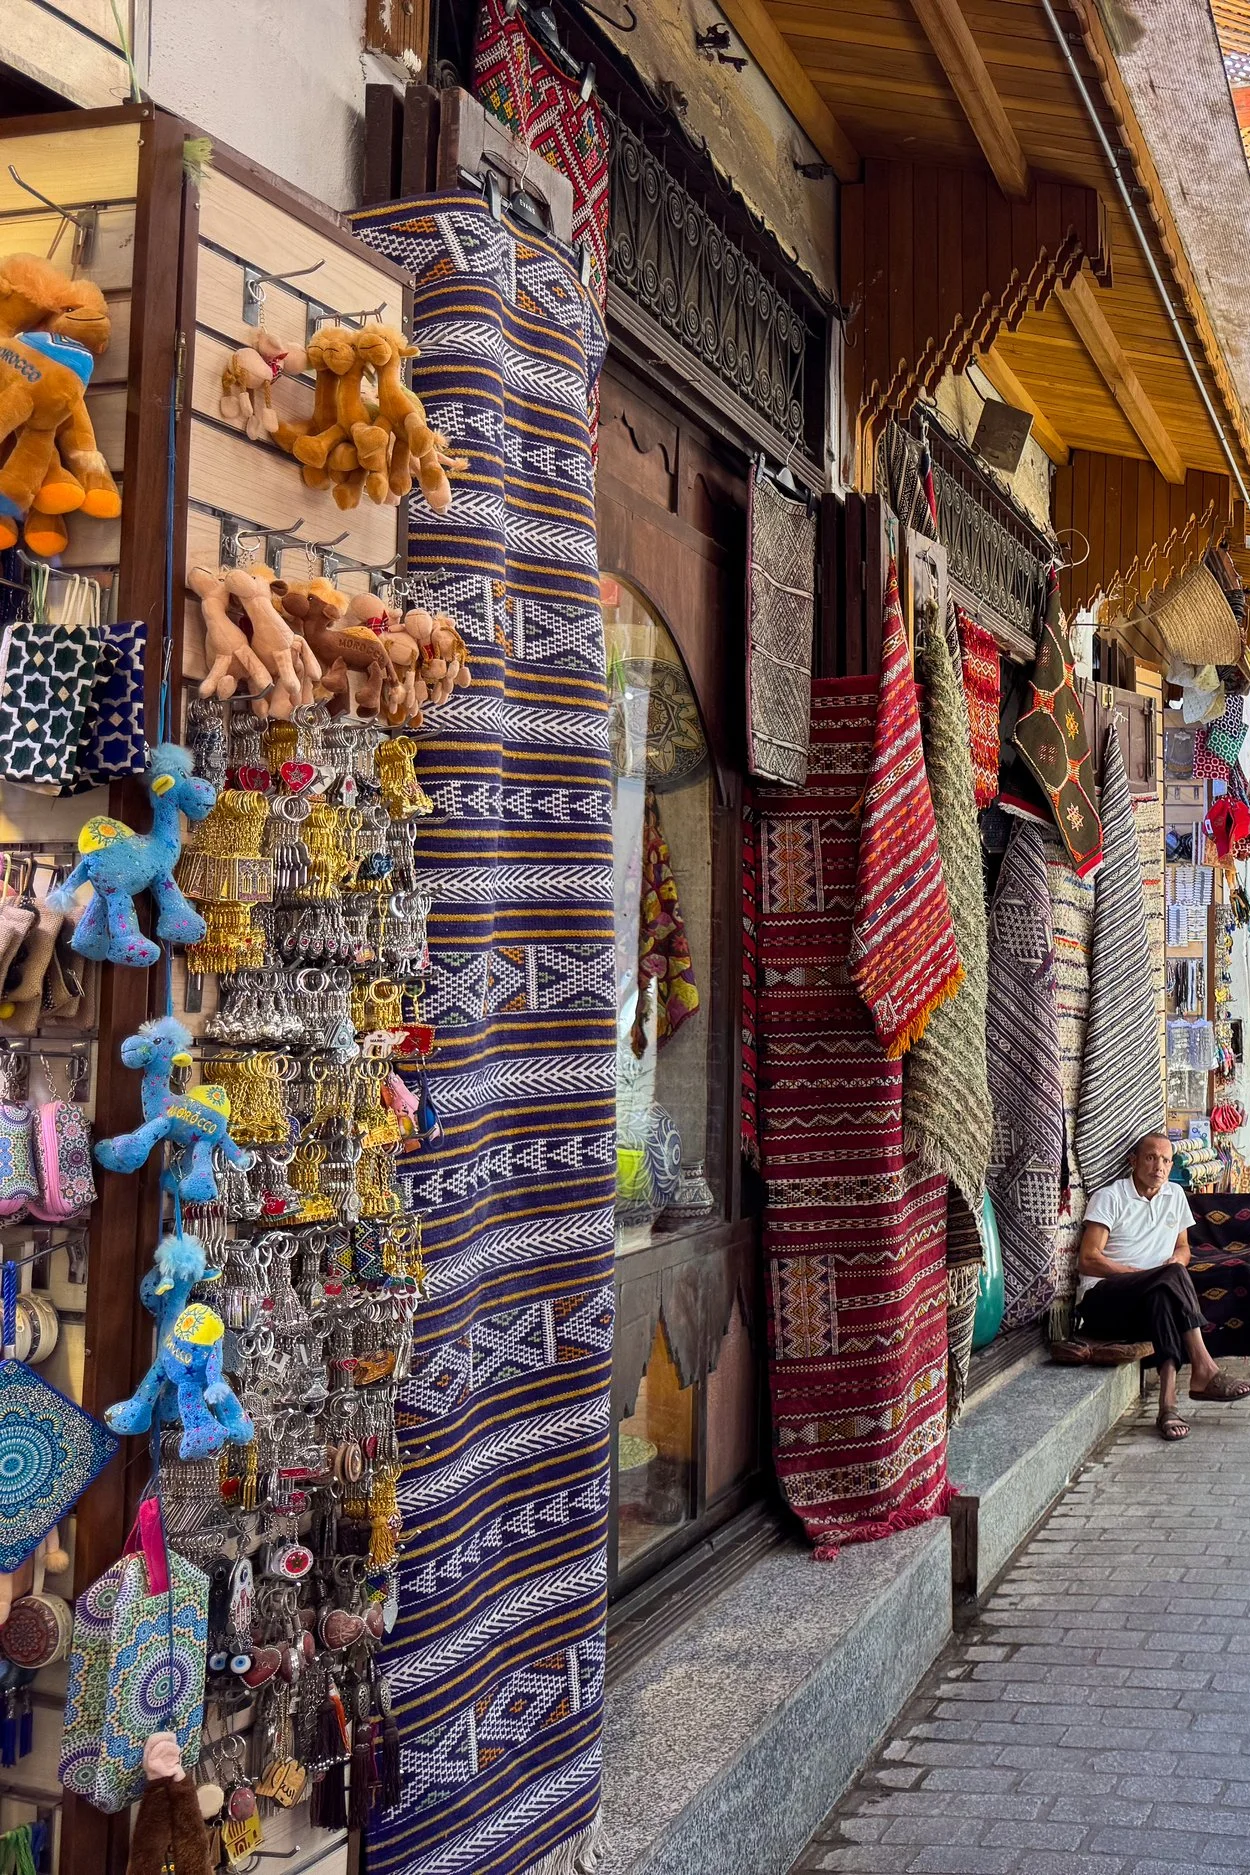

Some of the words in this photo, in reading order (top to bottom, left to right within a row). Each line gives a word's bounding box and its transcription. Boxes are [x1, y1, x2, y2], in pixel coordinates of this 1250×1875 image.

[0, 347, 42, 383] ROCCO
[338, 637, 385, 664] MOROCCO
[166, 1103, 218, 1134] MOROCCO
